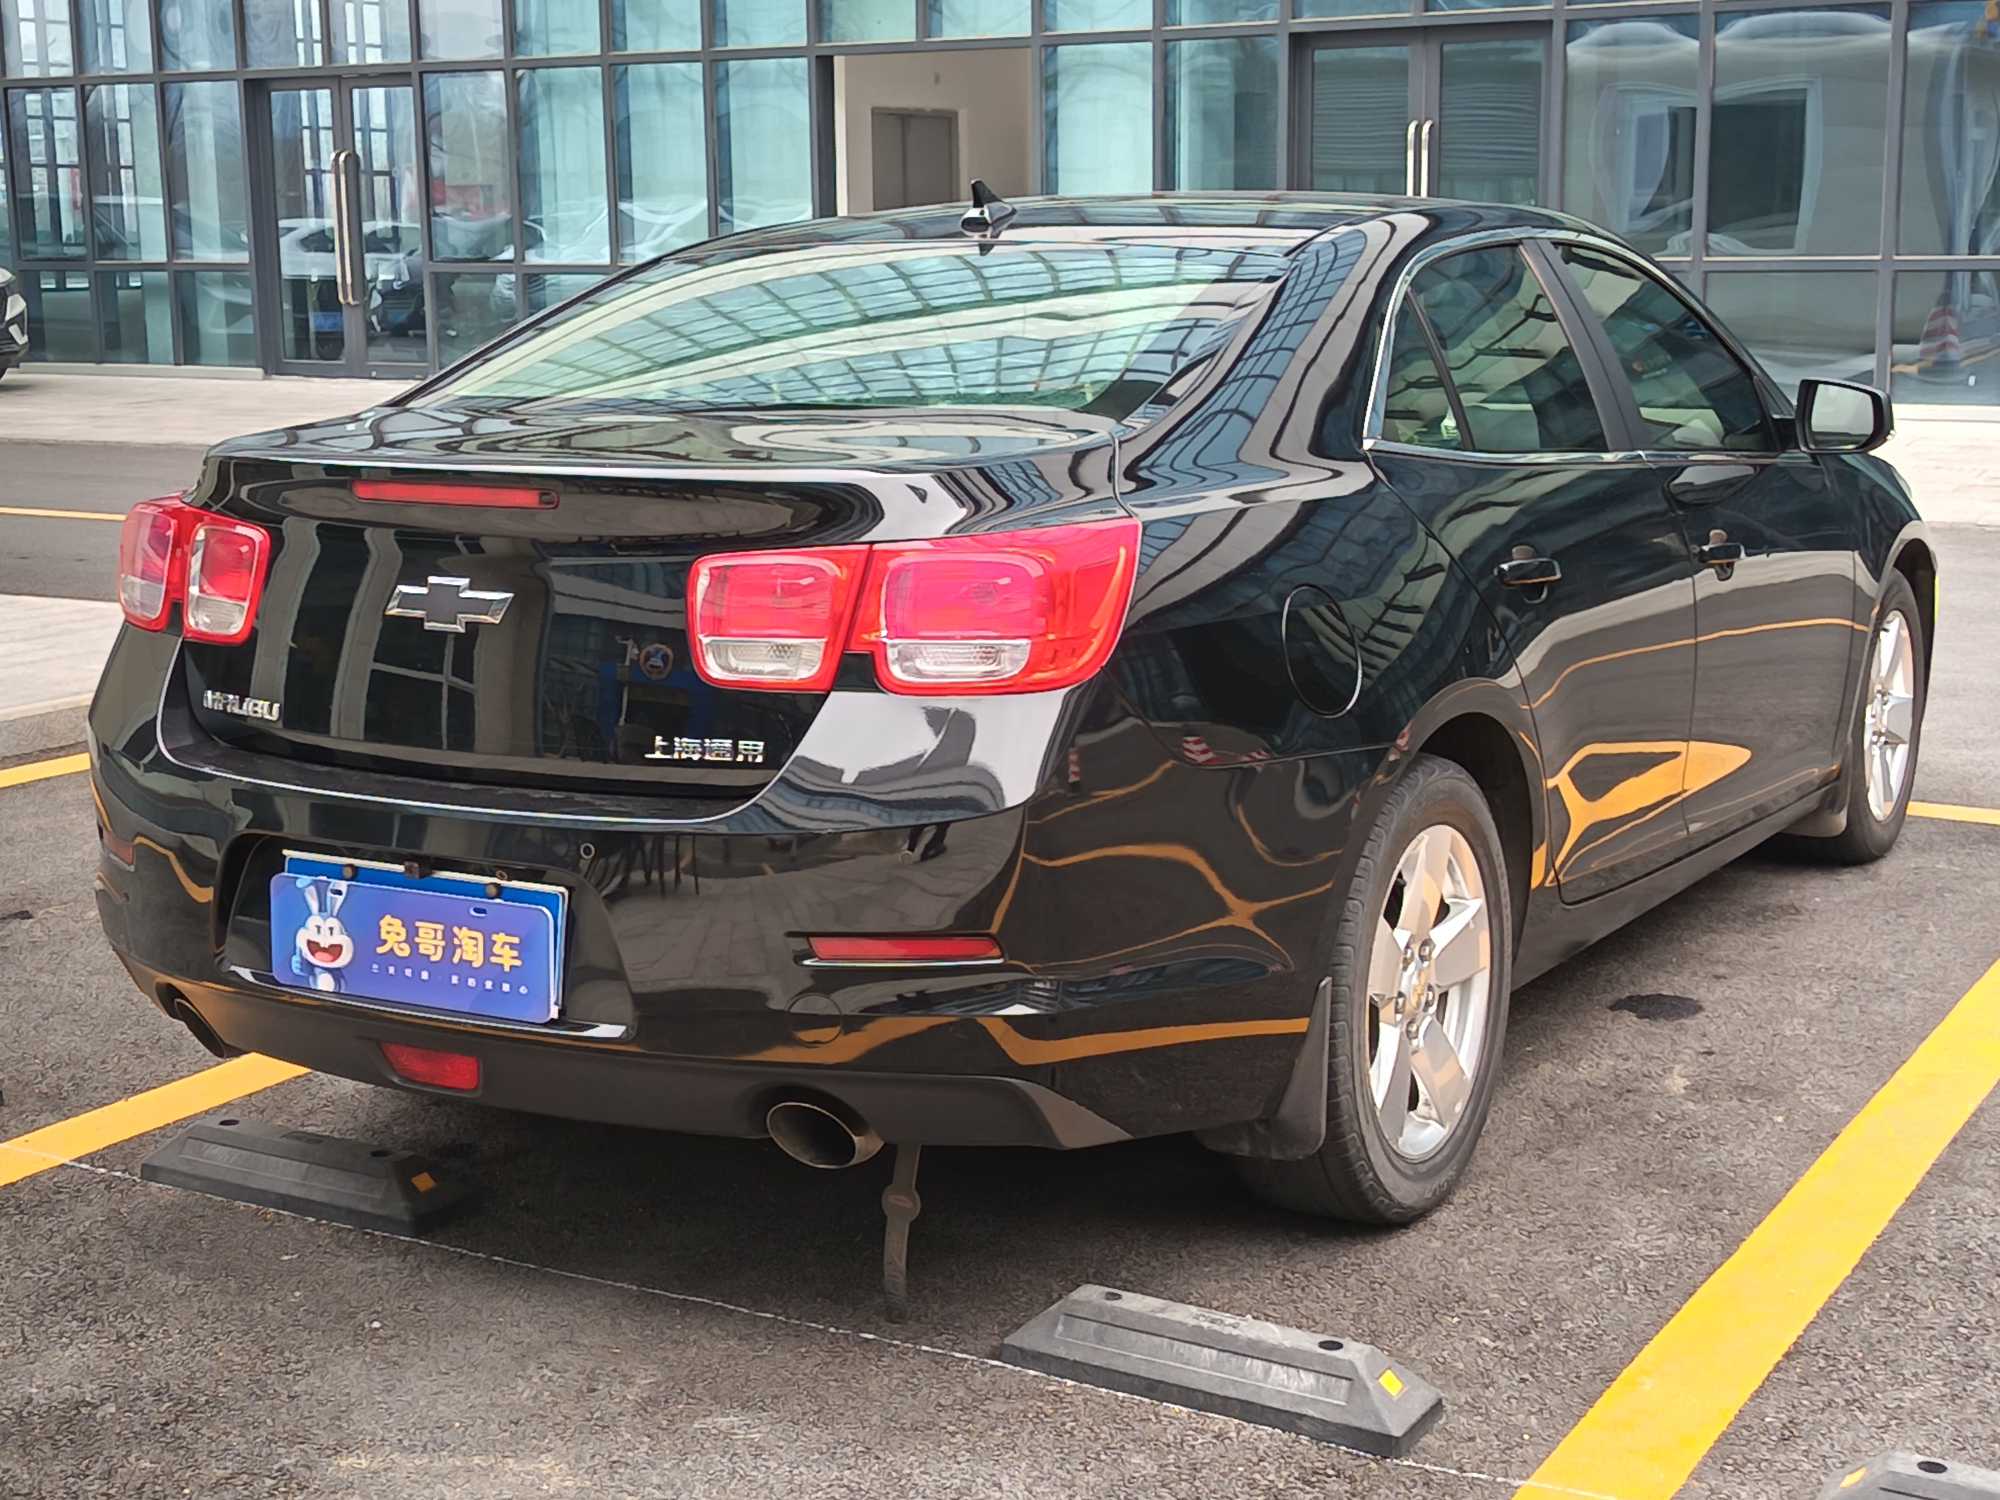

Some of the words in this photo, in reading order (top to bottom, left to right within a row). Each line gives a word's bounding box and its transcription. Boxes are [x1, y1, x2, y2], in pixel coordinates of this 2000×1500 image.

[644, 735, 765, 762] 上海通用
[375, 914, 523, 973] 兔哥淘车
